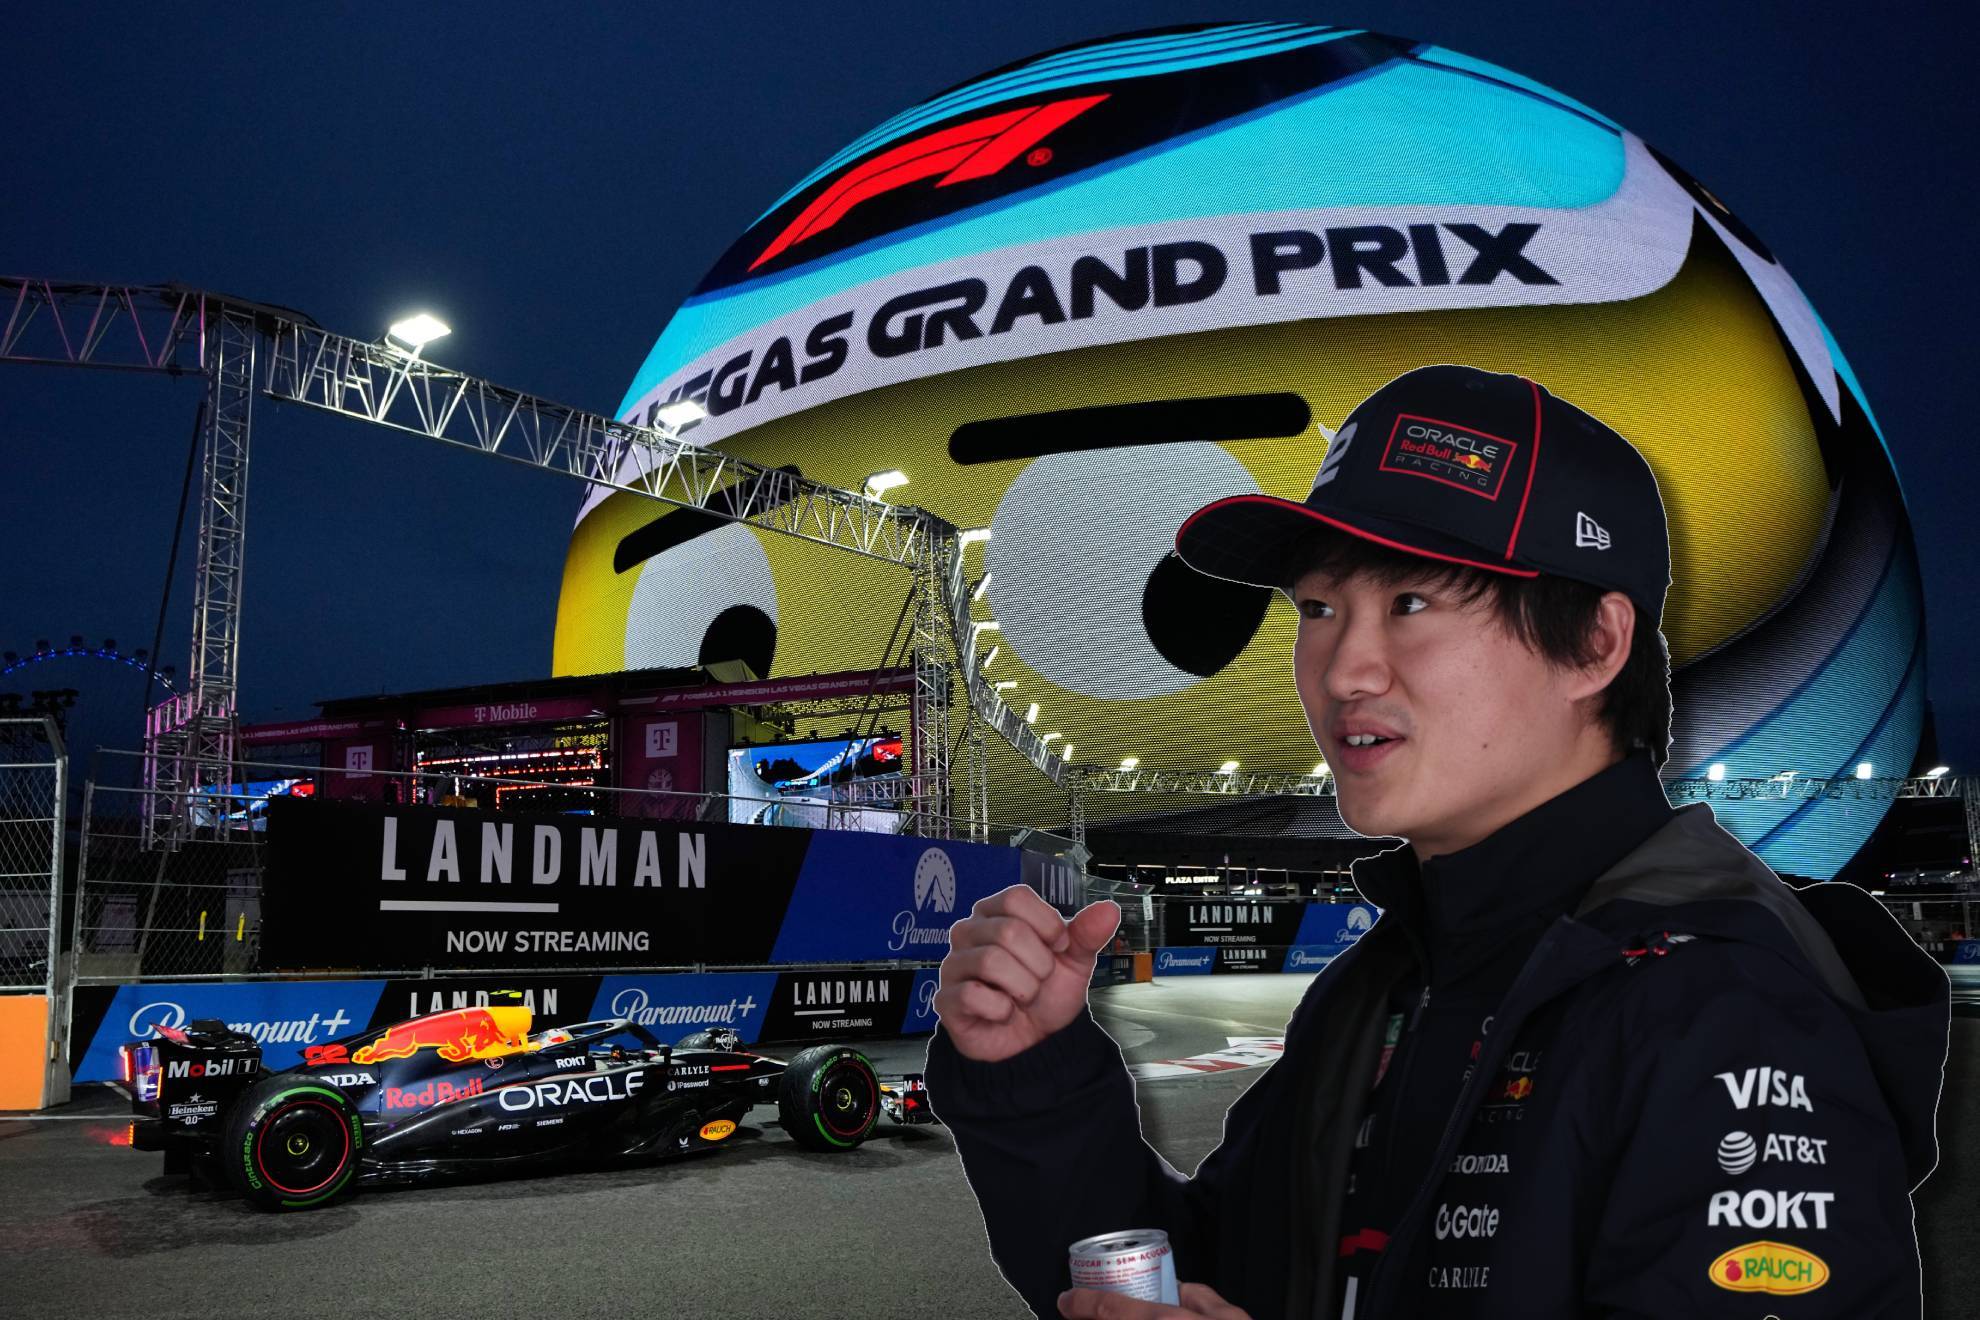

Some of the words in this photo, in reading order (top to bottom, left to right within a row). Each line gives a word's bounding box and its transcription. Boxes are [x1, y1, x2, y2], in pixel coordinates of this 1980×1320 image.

[867, 240, 1228, 358] GRAND
[1250, 223, 1561, 296] PRIX
[1400, 439, 1426, 454] Red
[1427, 444, 1452, 459] Bull
[1407, 425, 1499, 459] ORACLE
[1395, 455, 1488, 487] RACING
[381, 816, 706, 888] LANDMAN
[1165, 876, 1192, 884] PLAZA
[1193, 875, 1220, 884] ENTRY
[1189, 905, 1273, 924] LANDMAN
[447, 930, 508, 952] NOW
[514, 930, 650, 952] STREAMING
[1204, 935, 1220, 943] NOW
[1221, 935, 1256, 943] STREAMING
[1223, 949, 1267, 960] LANDMAN
[793, 979, 889, 1006] LANDMAN
[410, 988, 557, 1019] LANDAN
[611, 988, 757, 1027] Paramount+
[812, 1020, 830, 1030] NOW
[831, 1018, 872, 1029] STREAMING
[168, 1059, 234, 1078] Mobil
[555, 1056, 586, 1069] ROKT
[667, 1065, 709, 1076] CARLYLE
[320, 1072, 376, 1086] NDA
[904, 1080, 924, 1092] Mob
[1713, 1066, 1814, 1112] VISA
[386, 1084, 435, 1109] Red
[438, 1077, 483, 1104] Bull
[499, 1071, 644, 1111] ORACLE
[172, 1105, 214, 1116] Heineken
[1763, 1133, 1827, 1164] AT&T
[1708, 1189, 1835, 1229] ROKT
[1116, 1255, 1136, 1265] SEM
[1744, 1256, 1813, 1282] RAUCH
[1428, 1267, 1490, 1288] CARLYLE
